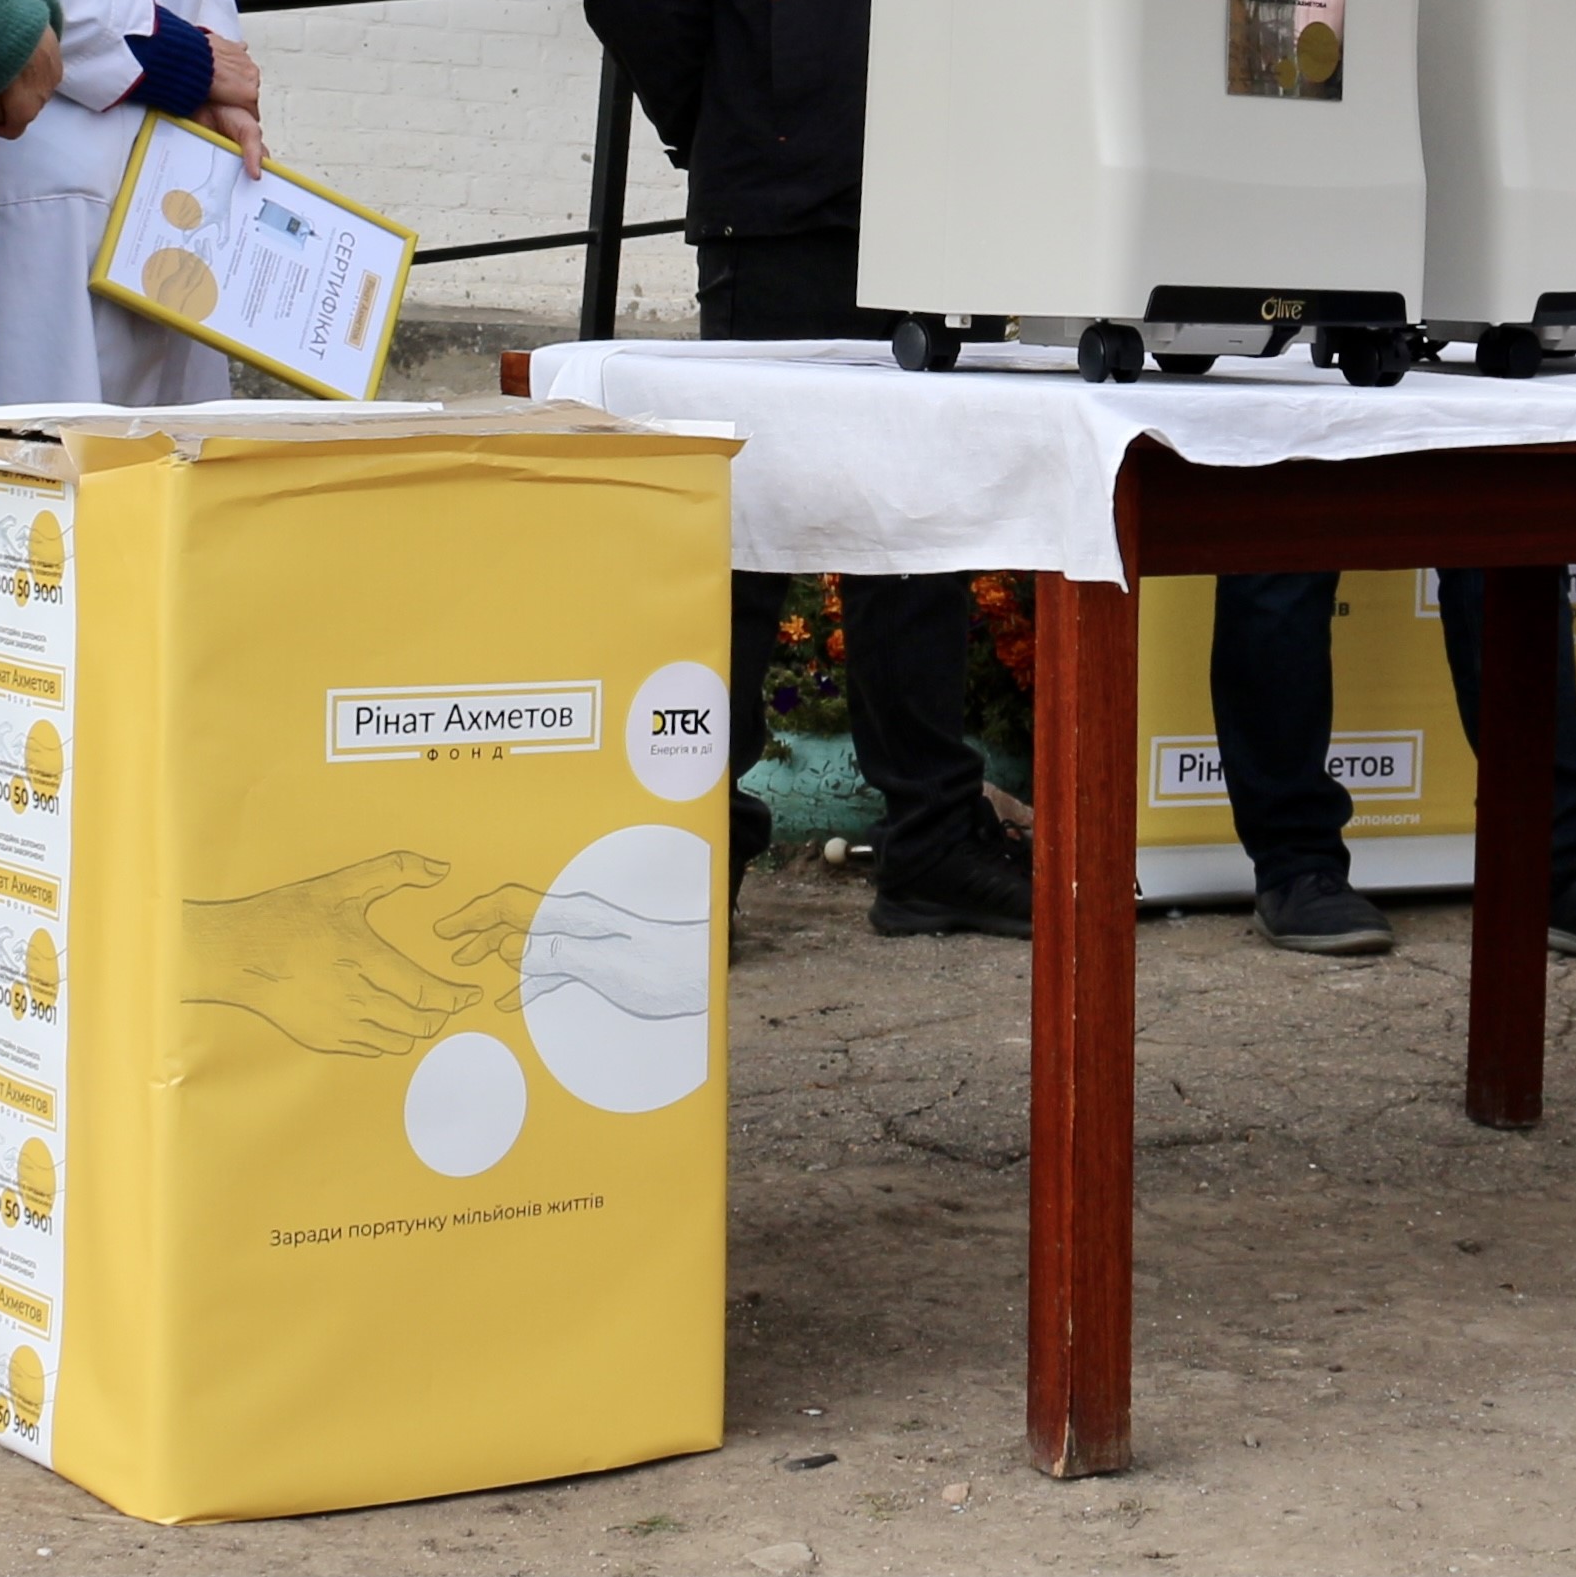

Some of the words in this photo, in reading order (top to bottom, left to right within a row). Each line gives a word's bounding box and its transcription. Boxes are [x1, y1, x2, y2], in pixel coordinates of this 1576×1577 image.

[309, 230, 355, 361] СЕРТИФІКАТ
[1261, 296, 1303, 321] Olive
[17, 579, 31, 599] 50
[33, 582, 63, 605] 9001
[12, 668, 56, 694] Ахметов
[354, 706, 436, 736] Рінат
[444, 703, 574, 733] Ахметов
[1178, 752, 1223, 782] Рін
[1327, 755, 1395, 778] етов
[13, 785, 29, 806] 50
[32, 790, 60, 816] 9001
[10, 874, 53, 904] Ахметов
[14, 992, 27, 1013] 50
[30, 998, 57, 1025] 9001
[5, 1199, 20, 1221] 50
[23, 1207, 53, 1236] 9001
[269, 1225, 343, 1248] Заради
[349, 1215, 447, 1239] порятунку
[452, 1200, 542, 1226] мільйонів
[547, 1192, 605, 1215] життів
[13, 1414, 39, 1445] 9001
